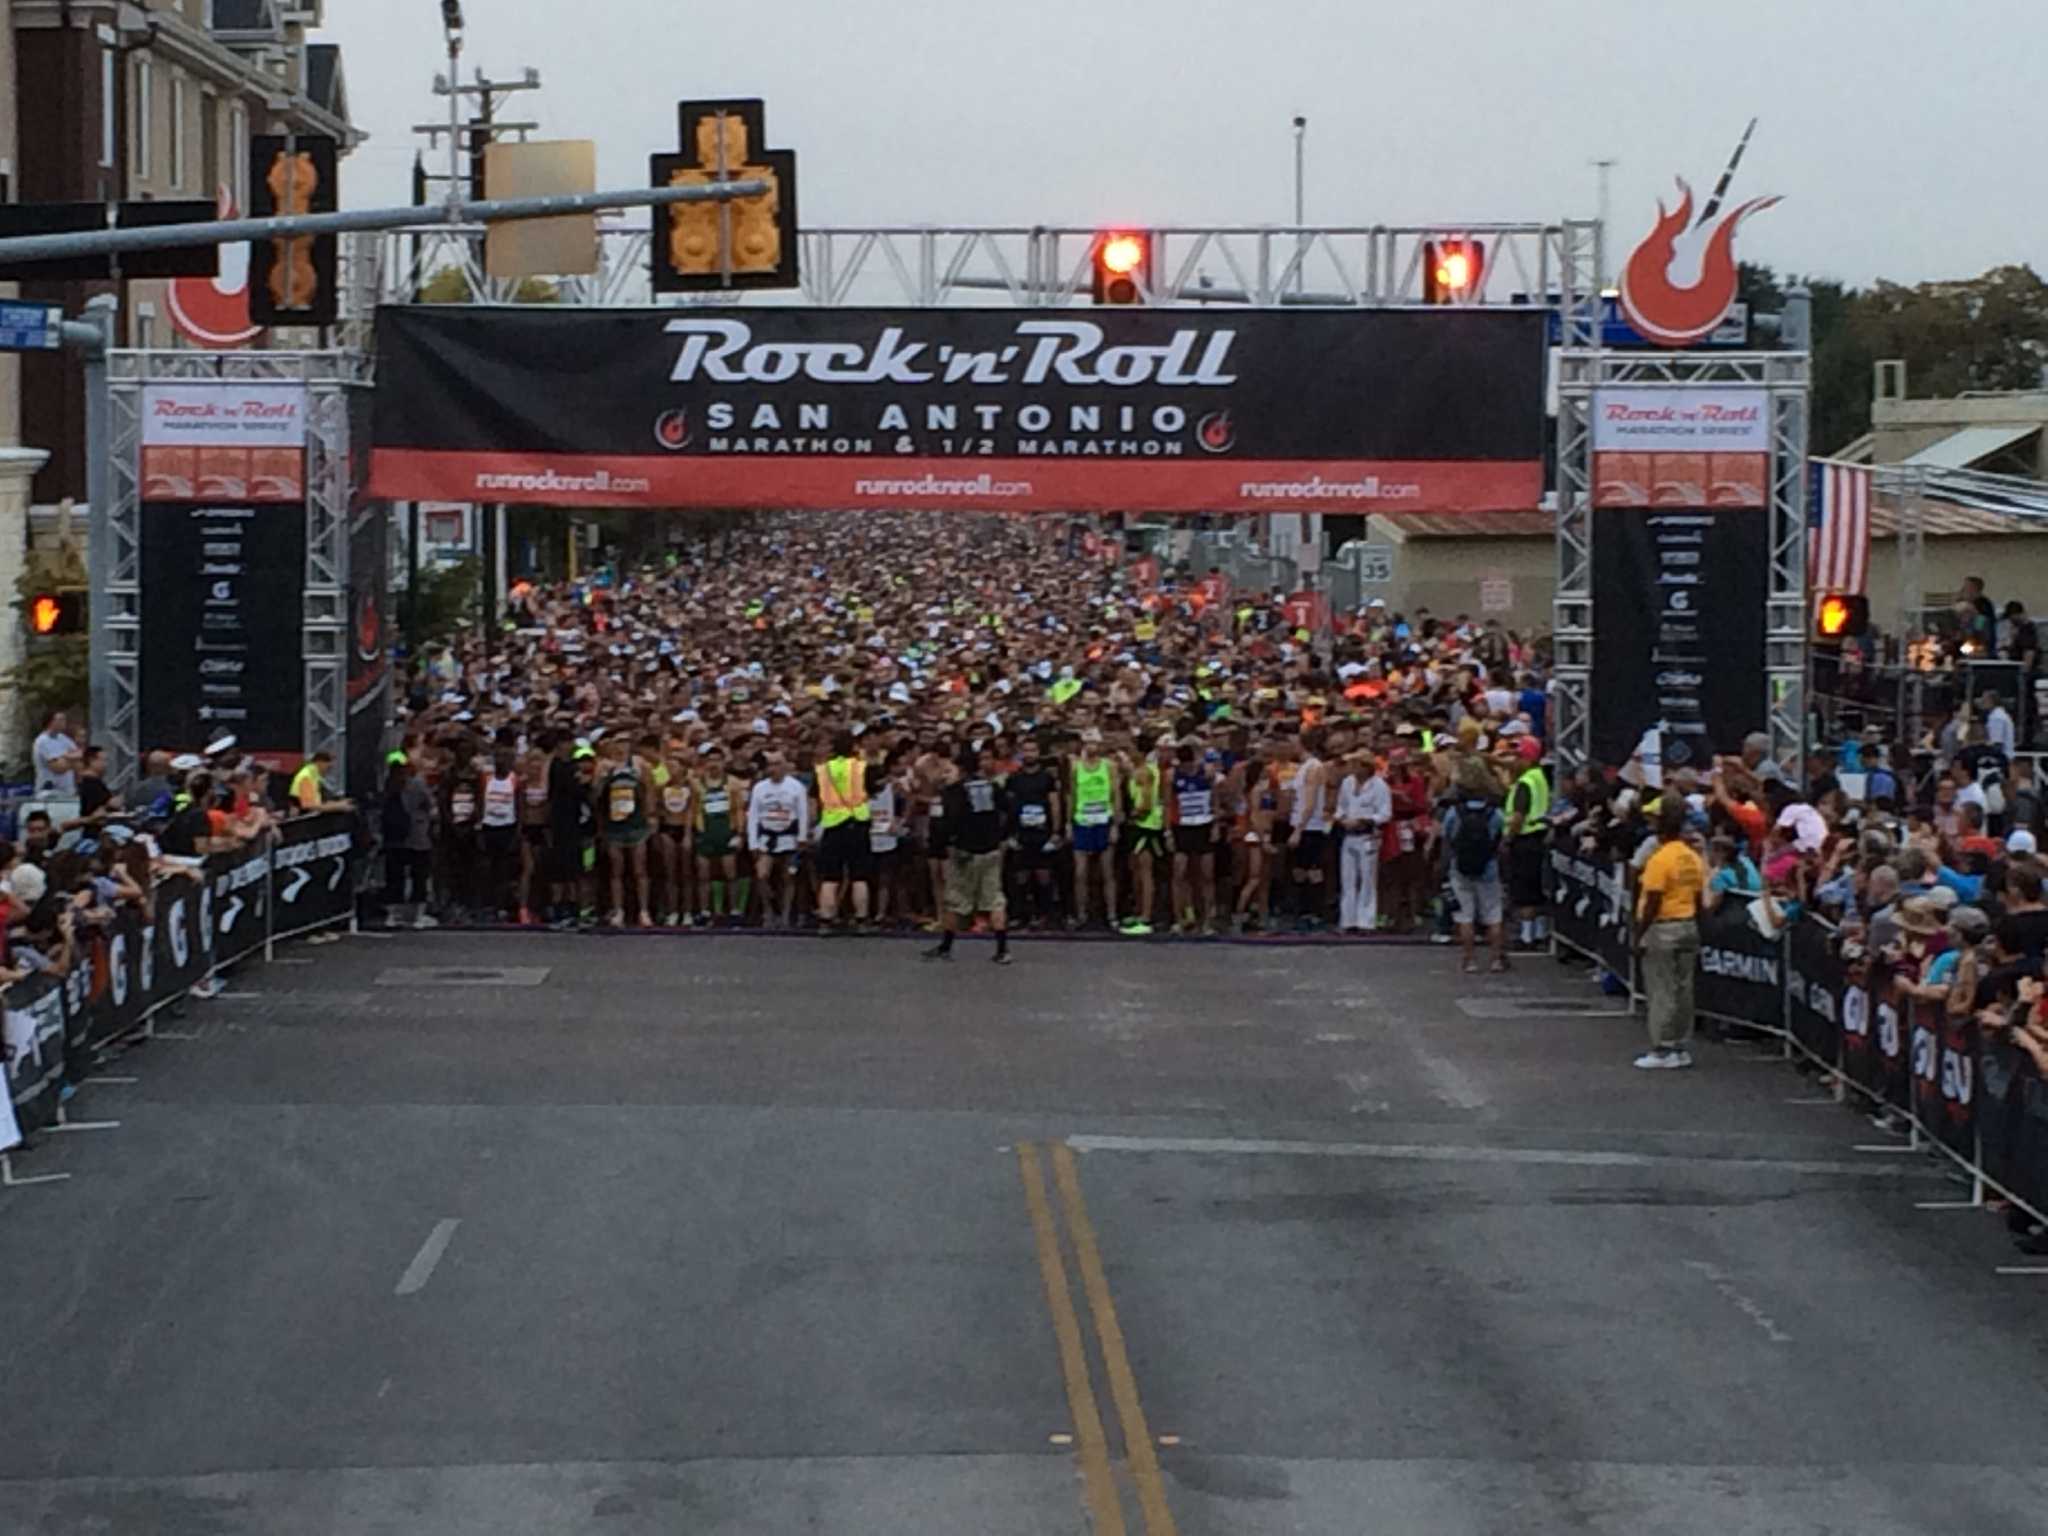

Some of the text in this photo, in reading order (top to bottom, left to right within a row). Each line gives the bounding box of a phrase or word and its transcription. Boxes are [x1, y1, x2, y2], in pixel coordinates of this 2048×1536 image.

[663, 318, 935, 383] Rock
[1016, 320, 1238, 386] Roll
[706, 402, 1186, 432] SAN ANTONIO
[1606, 403, 1675, 422] Rock
[709, 435, 1183, 455] MARATHON & 1/2 MARATHON
[476, 469, 649, 493] runrocknroll.com
[855, 473, 1033, 496] runrocknroll.com
[1240, 475, 1421, 498] runrocknroll.com
